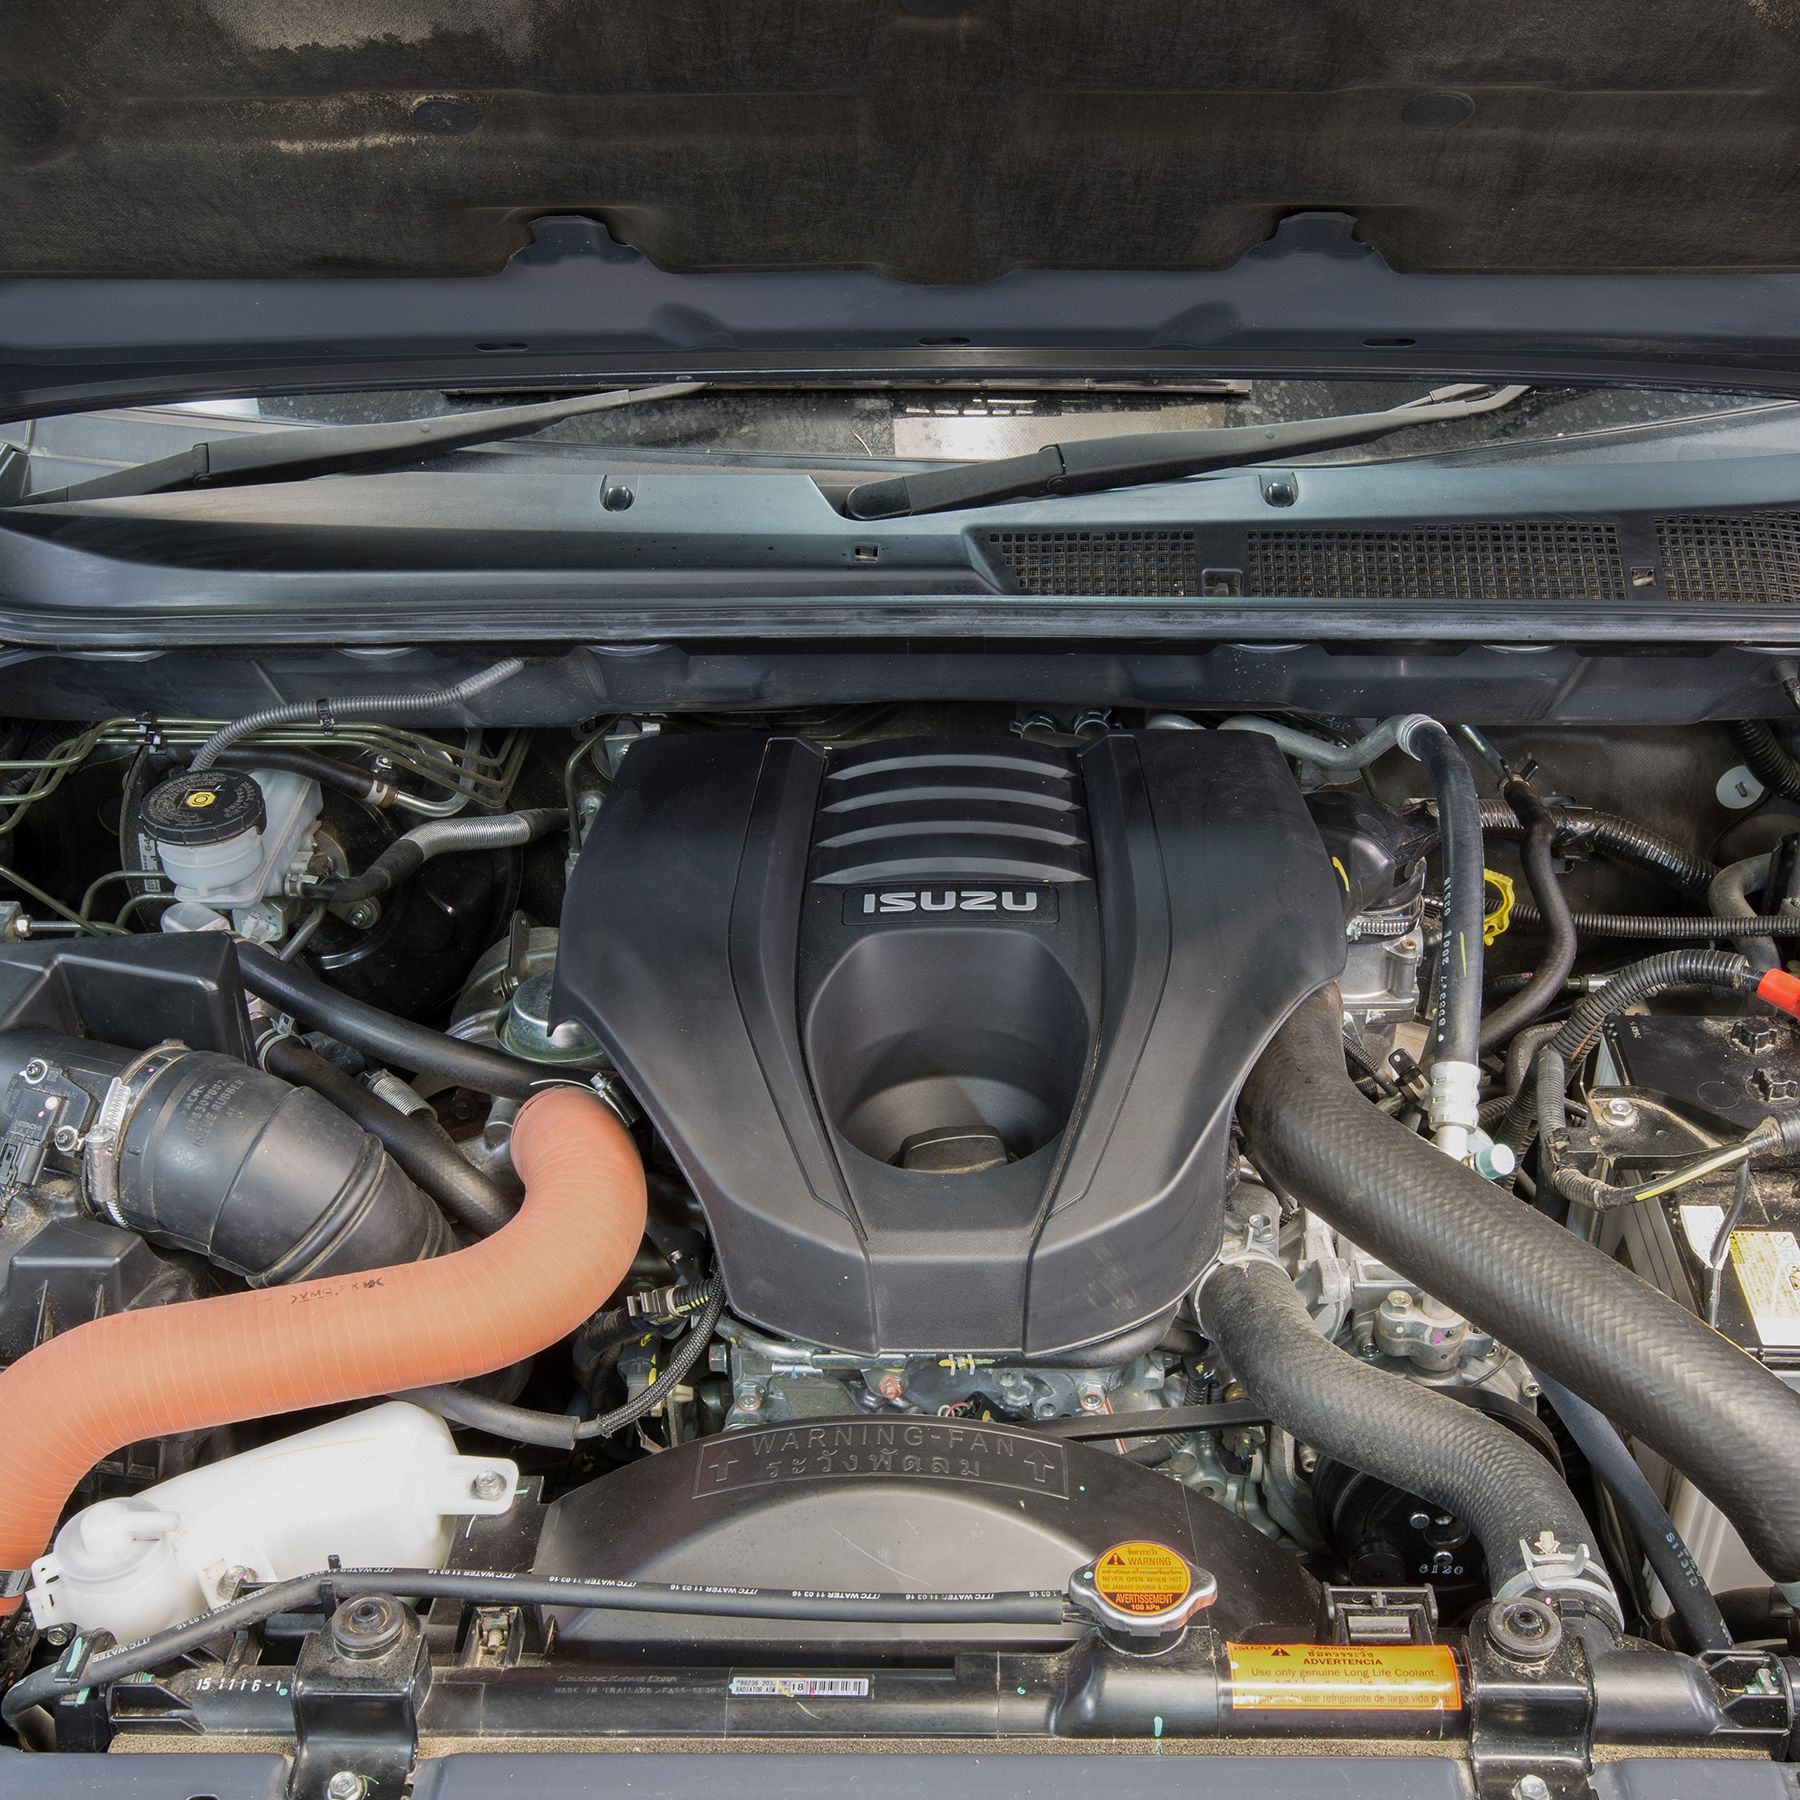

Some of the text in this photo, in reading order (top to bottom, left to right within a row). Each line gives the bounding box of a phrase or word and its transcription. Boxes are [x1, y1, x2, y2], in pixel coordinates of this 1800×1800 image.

[863, 891, 1037, 913] ISUZU
[752, 1425, 1014, 1457] WARNING-FAN
[765, 1448, 982, 1478] ระวังพัดลม
[1127, 1557, 1171, 1566] WARNING
[705, 1586, 737, 1594] WATER
[1115, 1594, 1173, 1604] AVERTISSEMENT
[1251, 1668, 1439, 1678] Use only genuine Long Life Coolant.
[791, 1683, 804, 1691] 18
[1323, 1693, 1371, 1704] refrigerante
[1374, 1694, 1384, 1703] de
[1387, 1694, 1408, 1704] larga
[1411, 1694, 1429, 1703] vida
